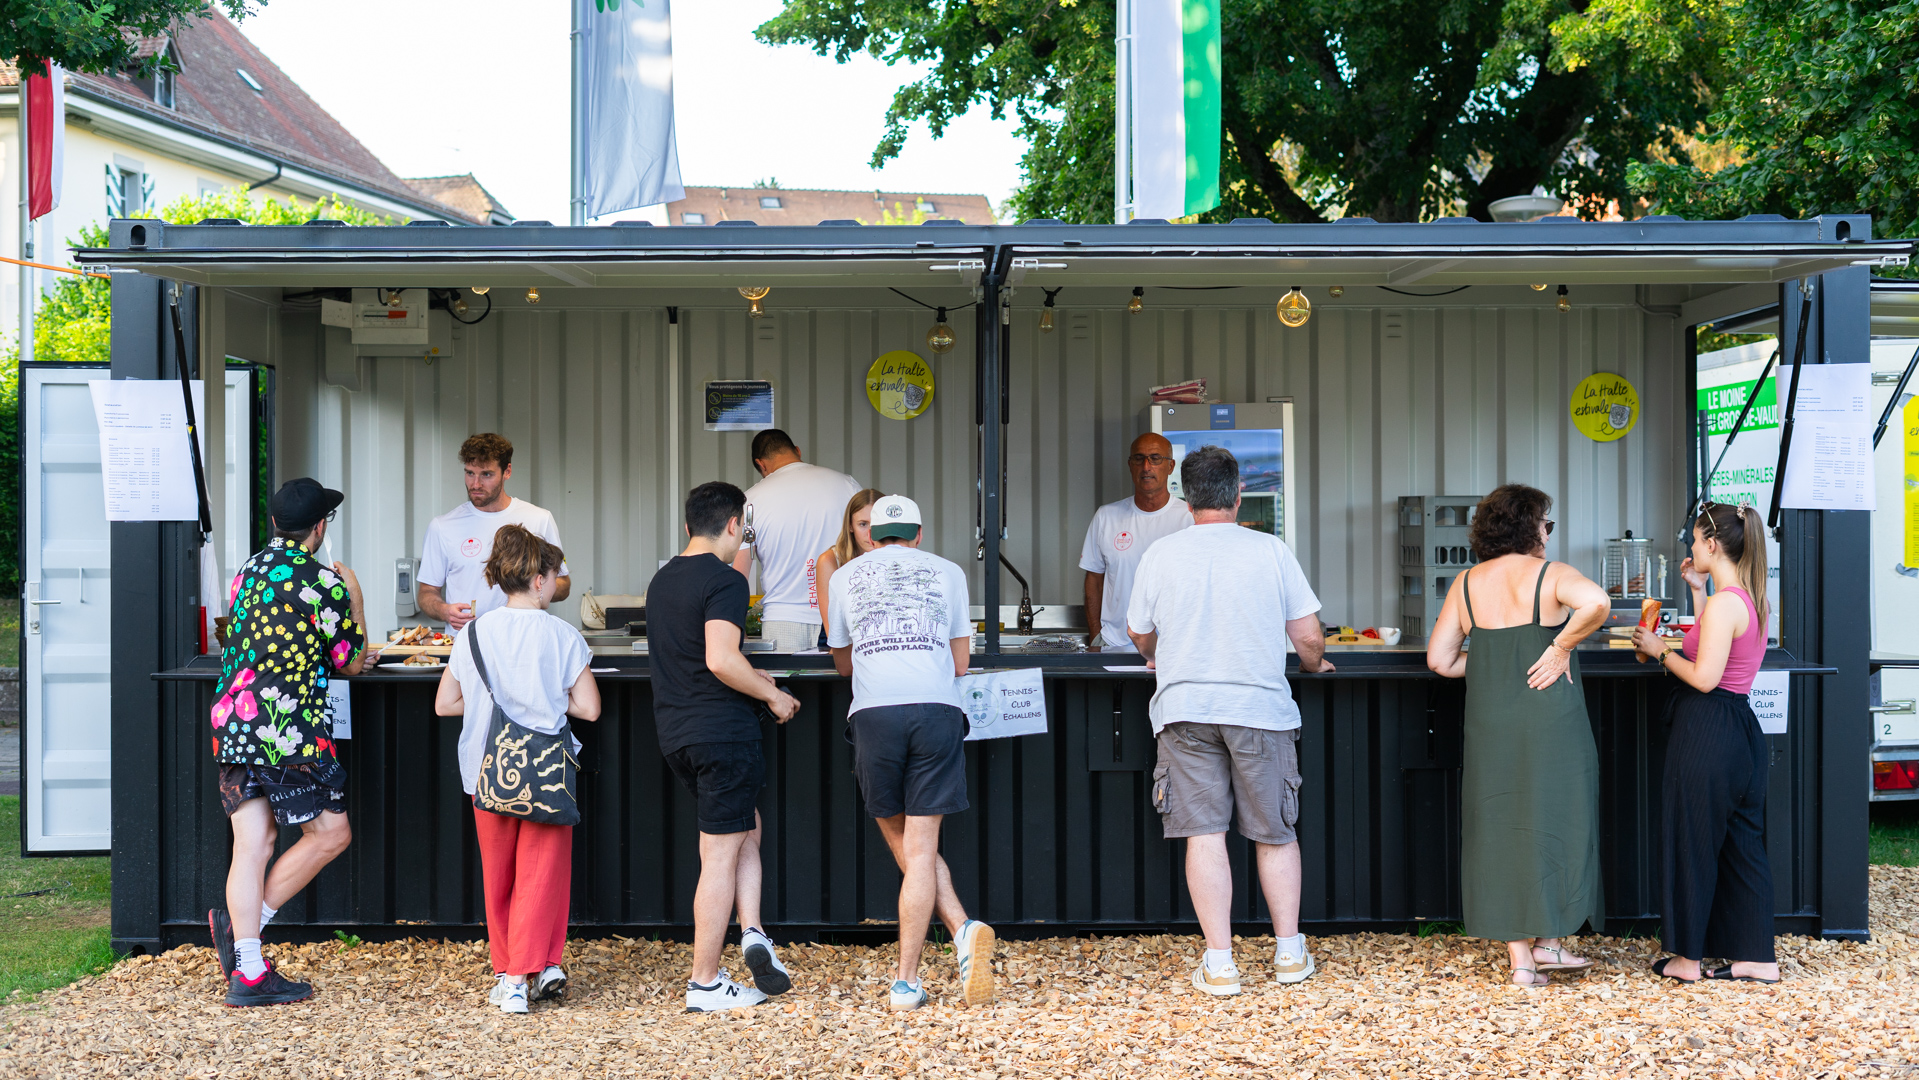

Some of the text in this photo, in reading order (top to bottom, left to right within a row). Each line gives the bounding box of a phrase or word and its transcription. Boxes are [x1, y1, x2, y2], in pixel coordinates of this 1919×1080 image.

[881, 360, 926, 377] La Halte
[869, 377, 906, 393] estivale
[1584, 381, 1628, 400] La Halte
[1707, 386, 1747, 410] LE MOINE
[1574, 398, 1611, 416] estivale
[854, 635, 946, 653] NATURE WILL LEAD YOU
[862, 643, 934, 657] TO GOOD PLACES
[1000, 687, 1038, 697] TENNIS-
[1011, 700, 1031, 709] CLUB
[1754, 700, 1775, 708] CLUB
[1002, 711, 1042, 721] ECHALLENS
[1883, 723, 1892, 735] 2
